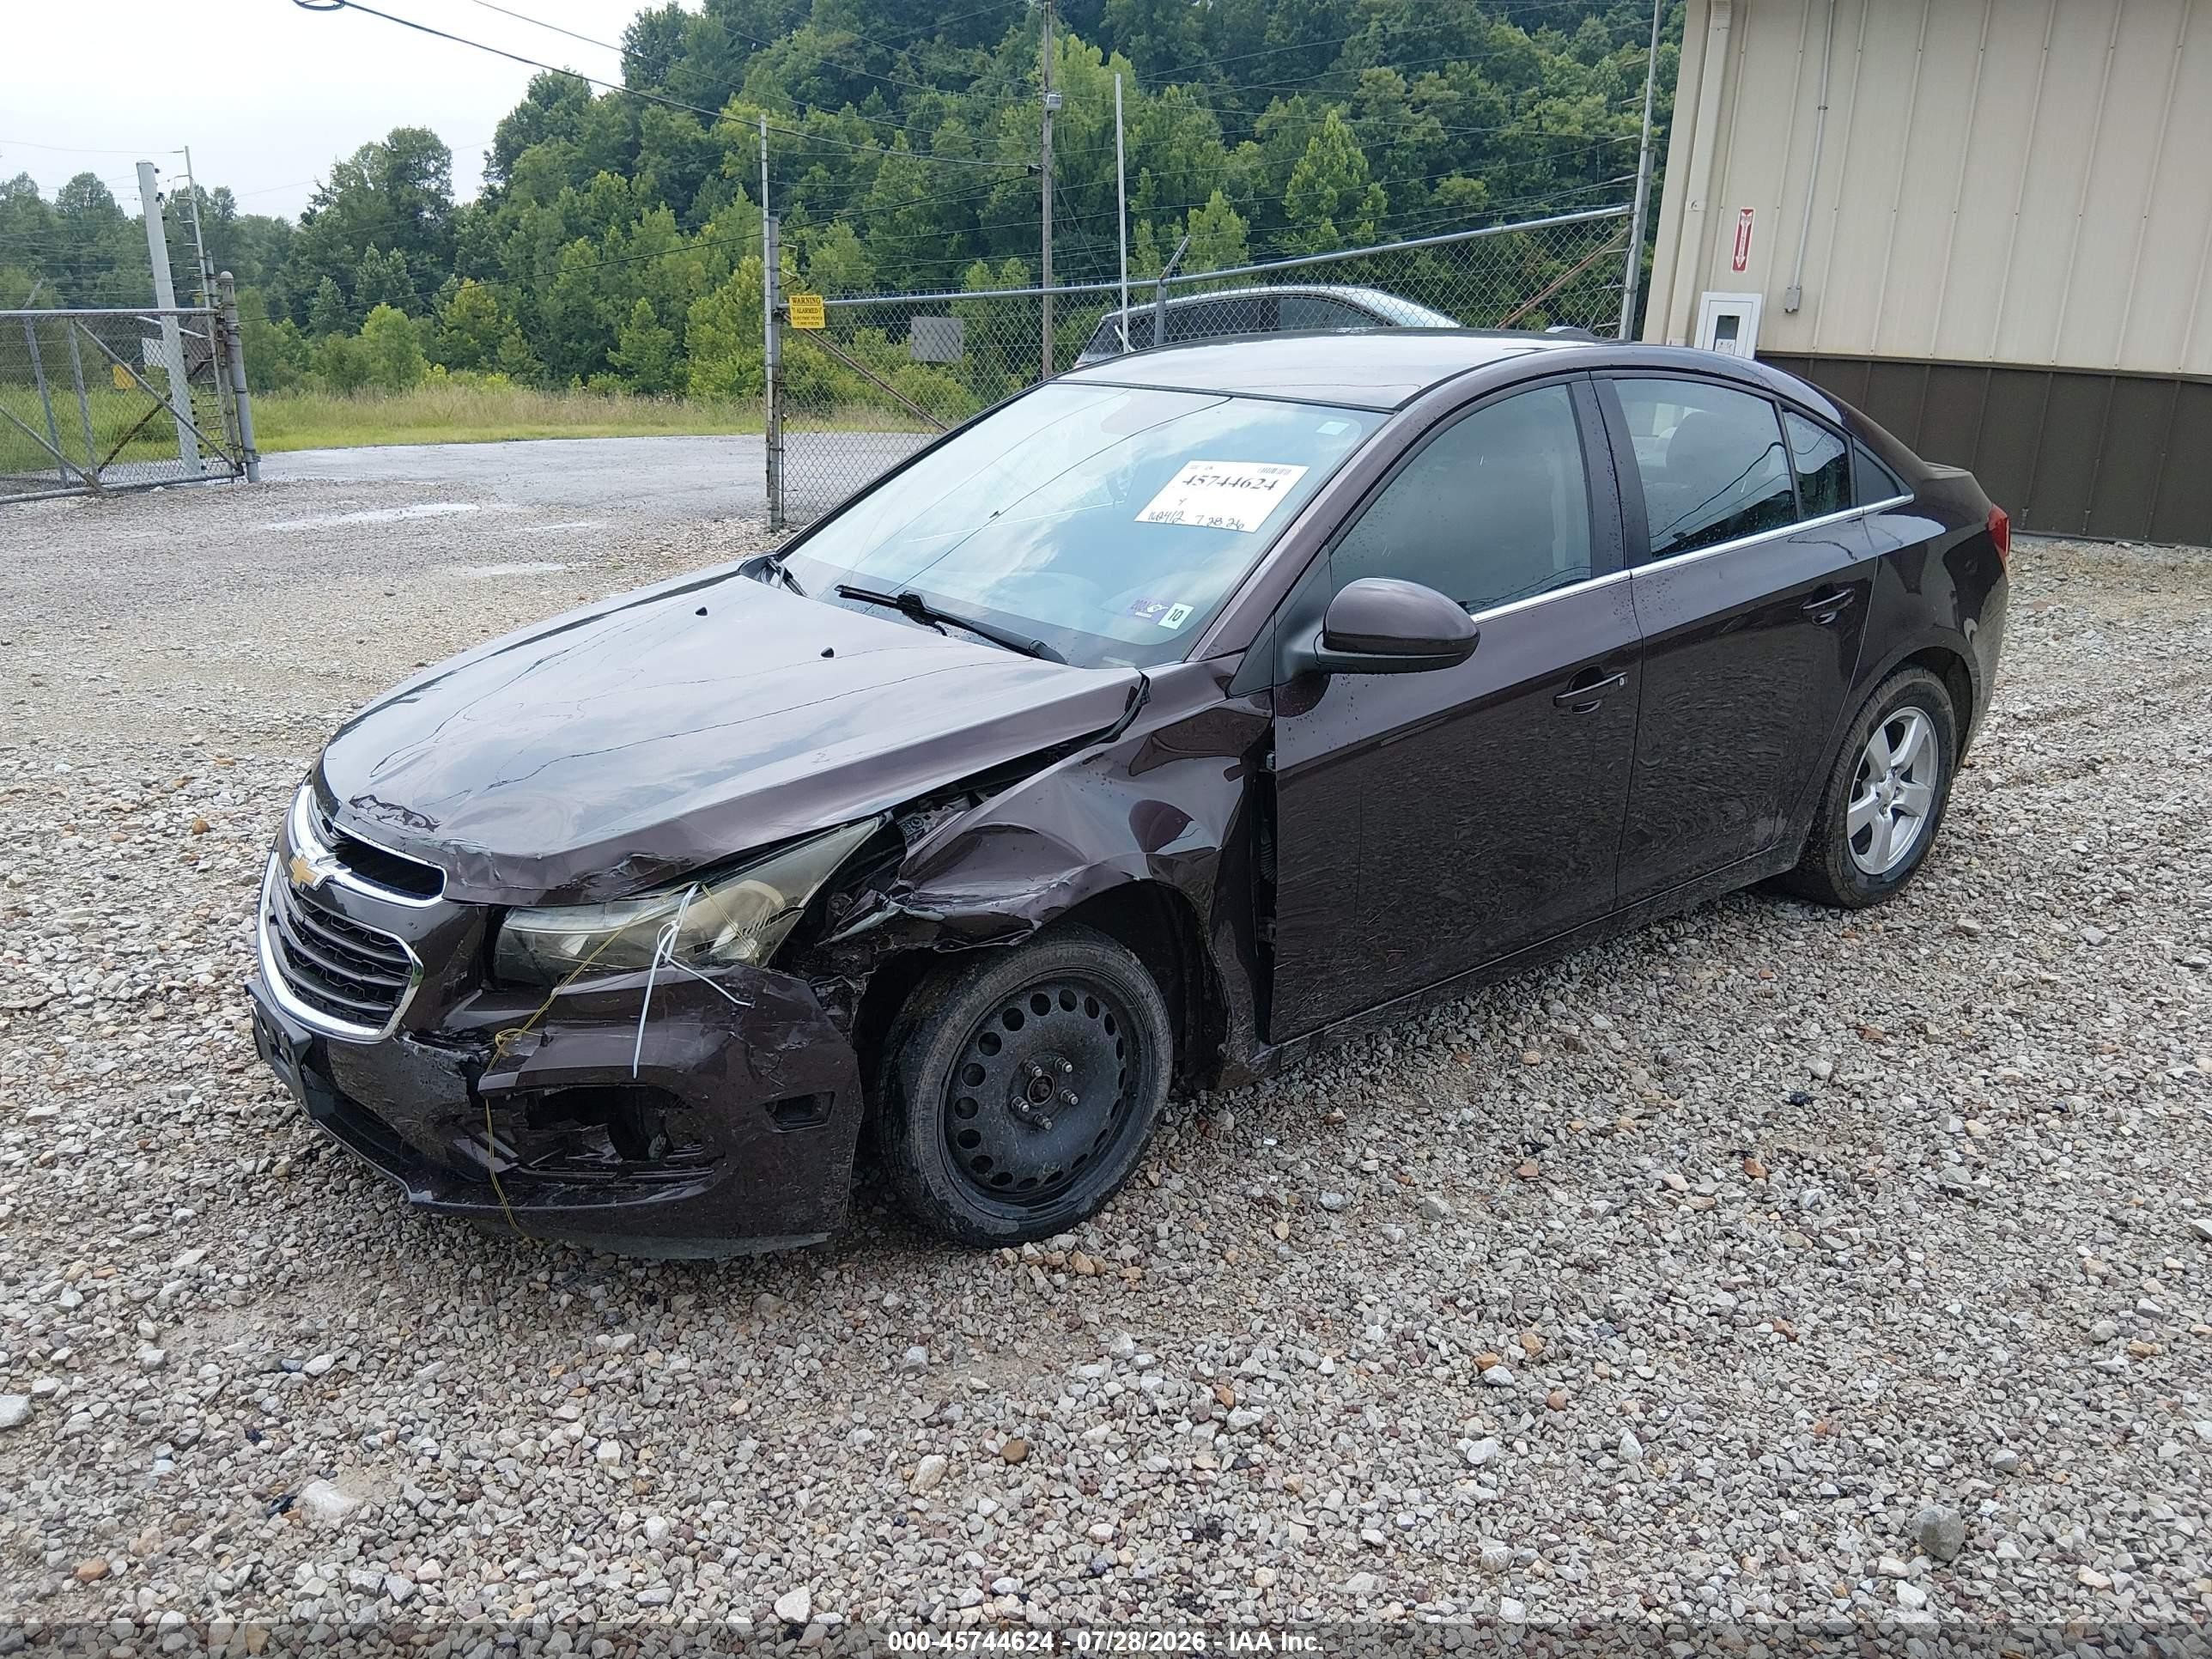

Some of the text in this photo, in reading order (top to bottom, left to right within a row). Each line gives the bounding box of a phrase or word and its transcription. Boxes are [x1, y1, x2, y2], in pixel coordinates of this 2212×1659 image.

[1182, 474, 1279, 490] 45744624
[1195, 515, 1205, 525] 7
[1225, 518, 1244, 530] 26
[1168, 609, 1184, 622] 10
